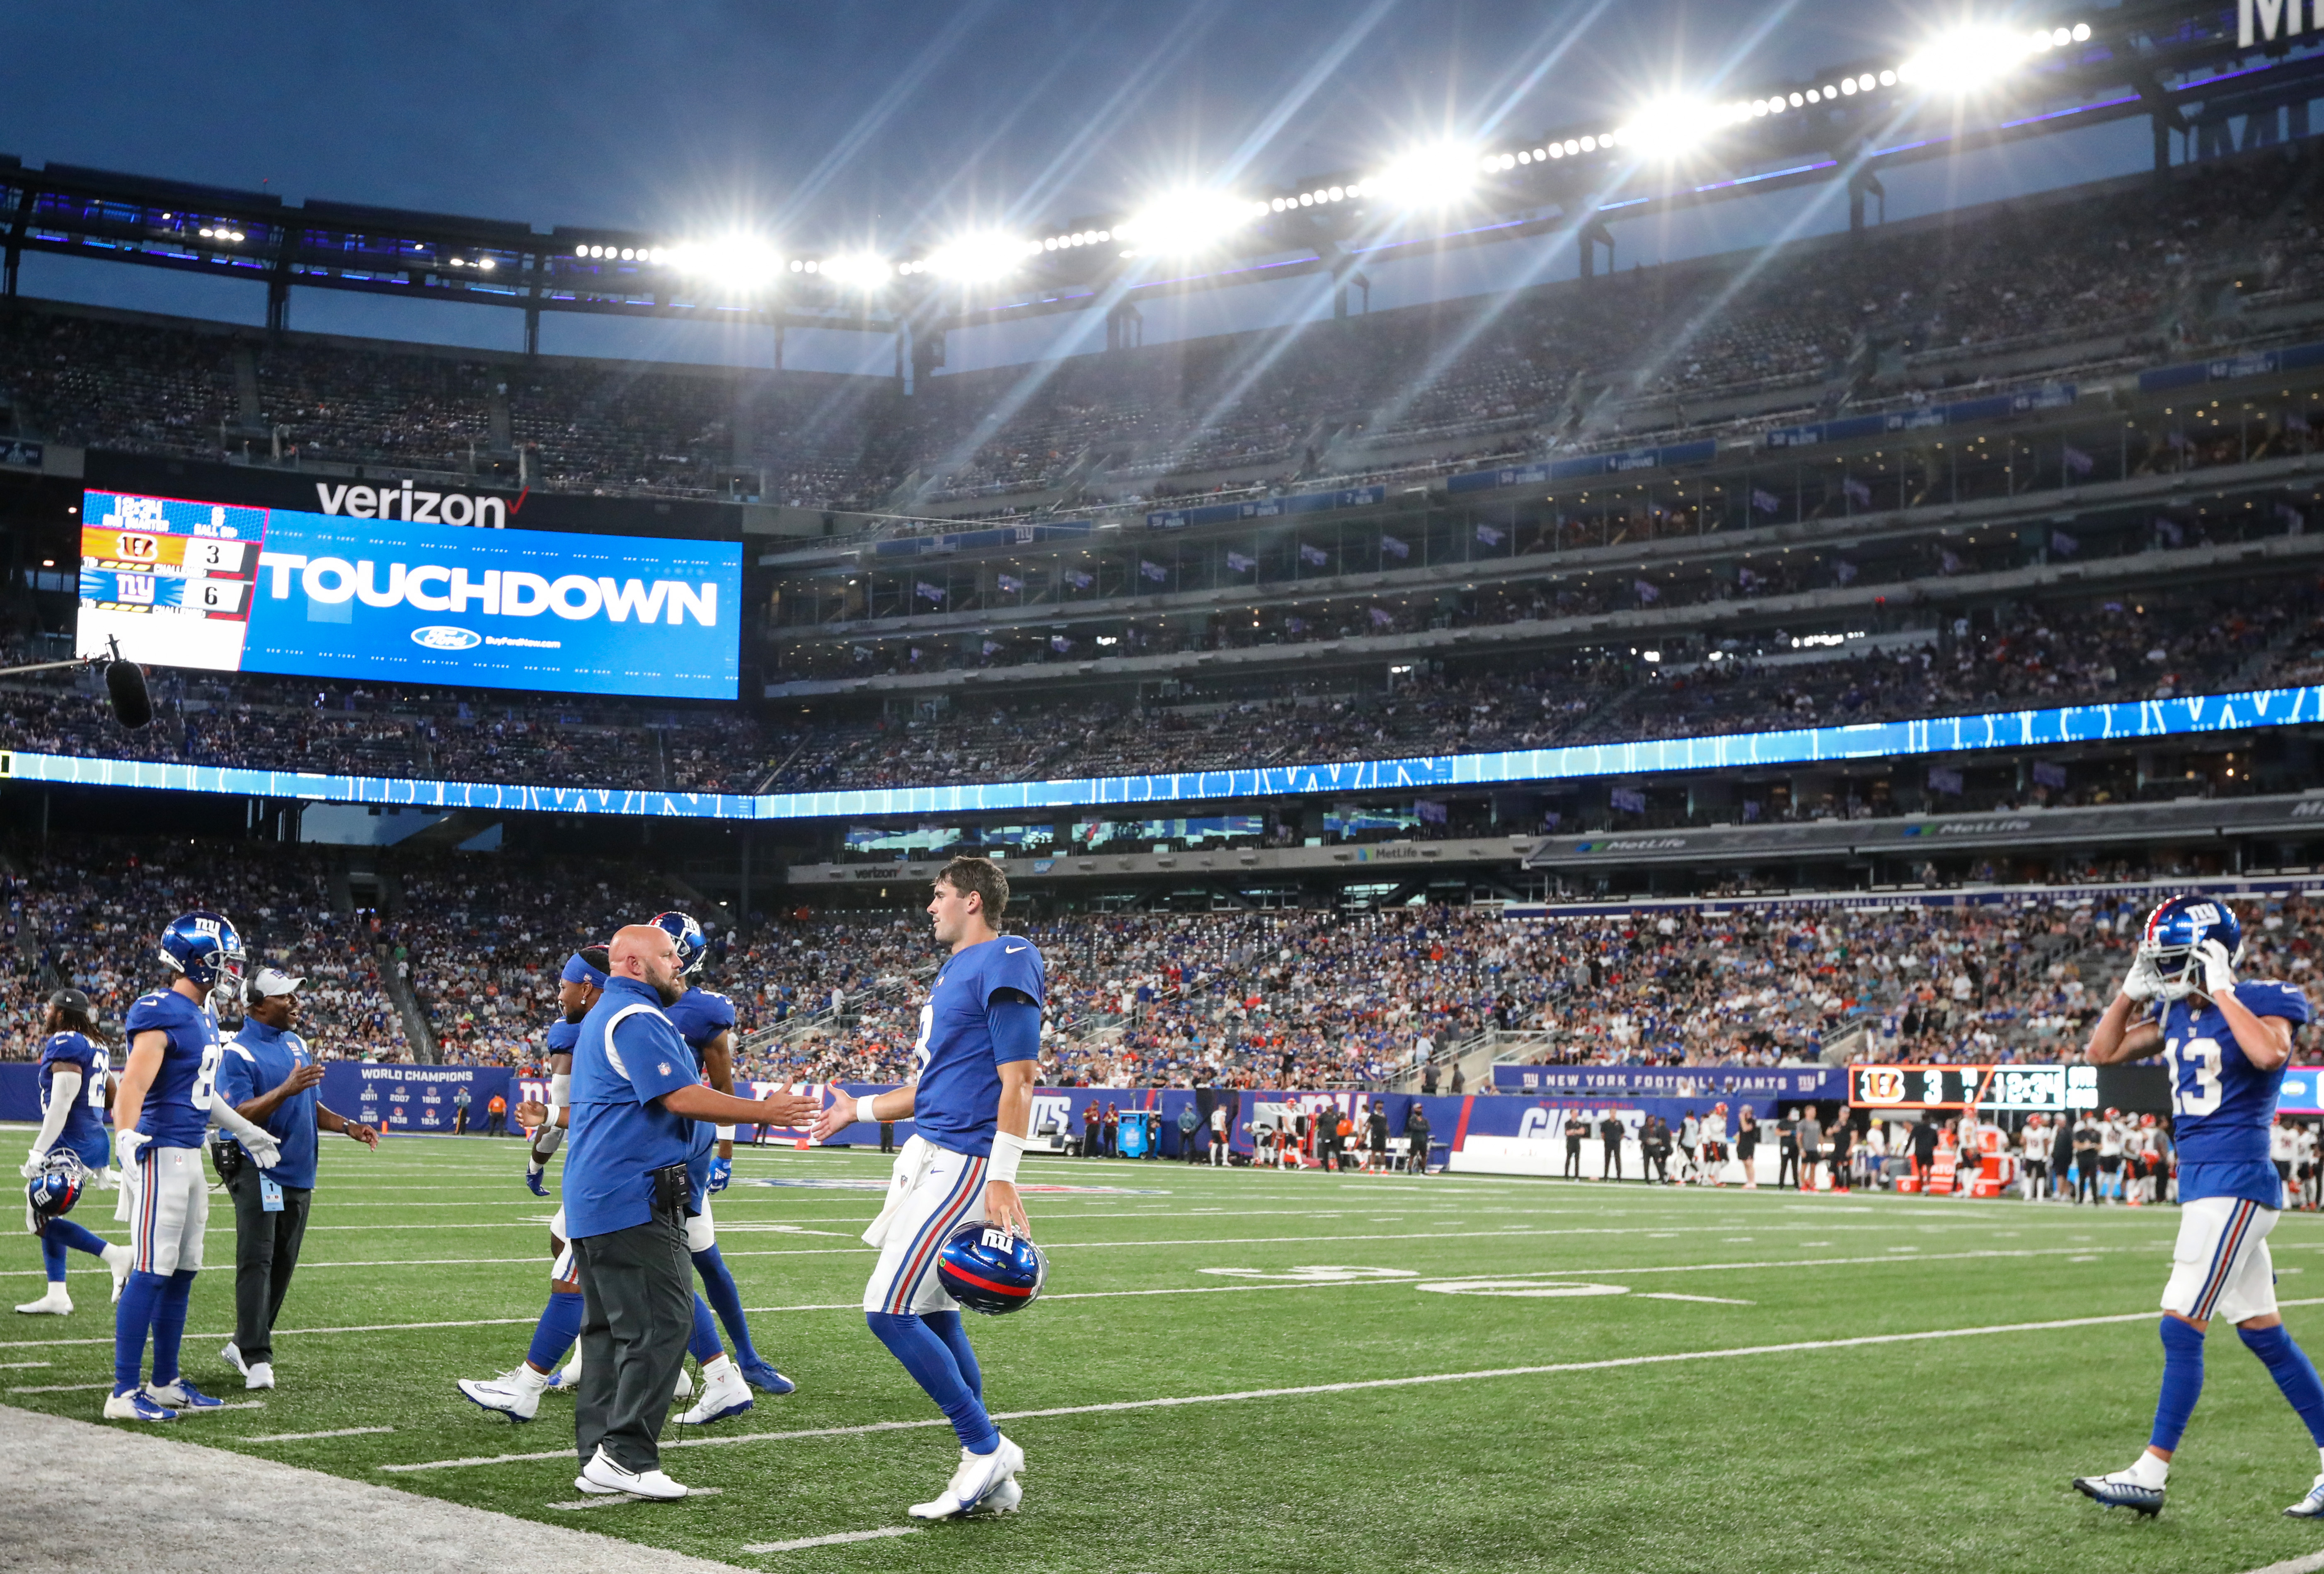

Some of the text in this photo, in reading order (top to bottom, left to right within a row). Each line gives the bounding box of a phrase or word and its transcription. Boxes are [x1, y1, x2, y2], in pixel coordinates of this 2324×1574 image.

[316, 479, 506, 530] verizon
[125, 517, 170, 532] QUARTER
[194, 524, 218, 537] BALL
[206, 546, 219, 564] 3
[205, 586, 218, 605] 6
[258, 552, 717, 626] TOUCHDOWN
[424, 628, 468, 647] Ford
[1607, 838, 1686, 851] MetLife
[1376, 847, 1417, 859] MetLife
[1034, 861, 1052, 873] SAP
[855, 868, 898, 880] verizon
[361, 1068, 474, 1082] WORLD CHAMPIONS
[1546, 1075, 1579, 1086] NEW
[1586, 1075, 1627, 1086] YORK
[2164, 1037, 2223, 1116] 13
[1923, 1069, 1942, 1105] 3
[1994, 1072, 2063, 1104] 12:34
[360, 1093, 378, 1101] 2011
[390, 1094, 410, 1103] 2007
[422, 1096, 441, 1104] 1990
[389, 1115, 408, 1124] 1938
[421, 1117, 440, 1125] 1934
[269, 1183, 274, 1192] 1
